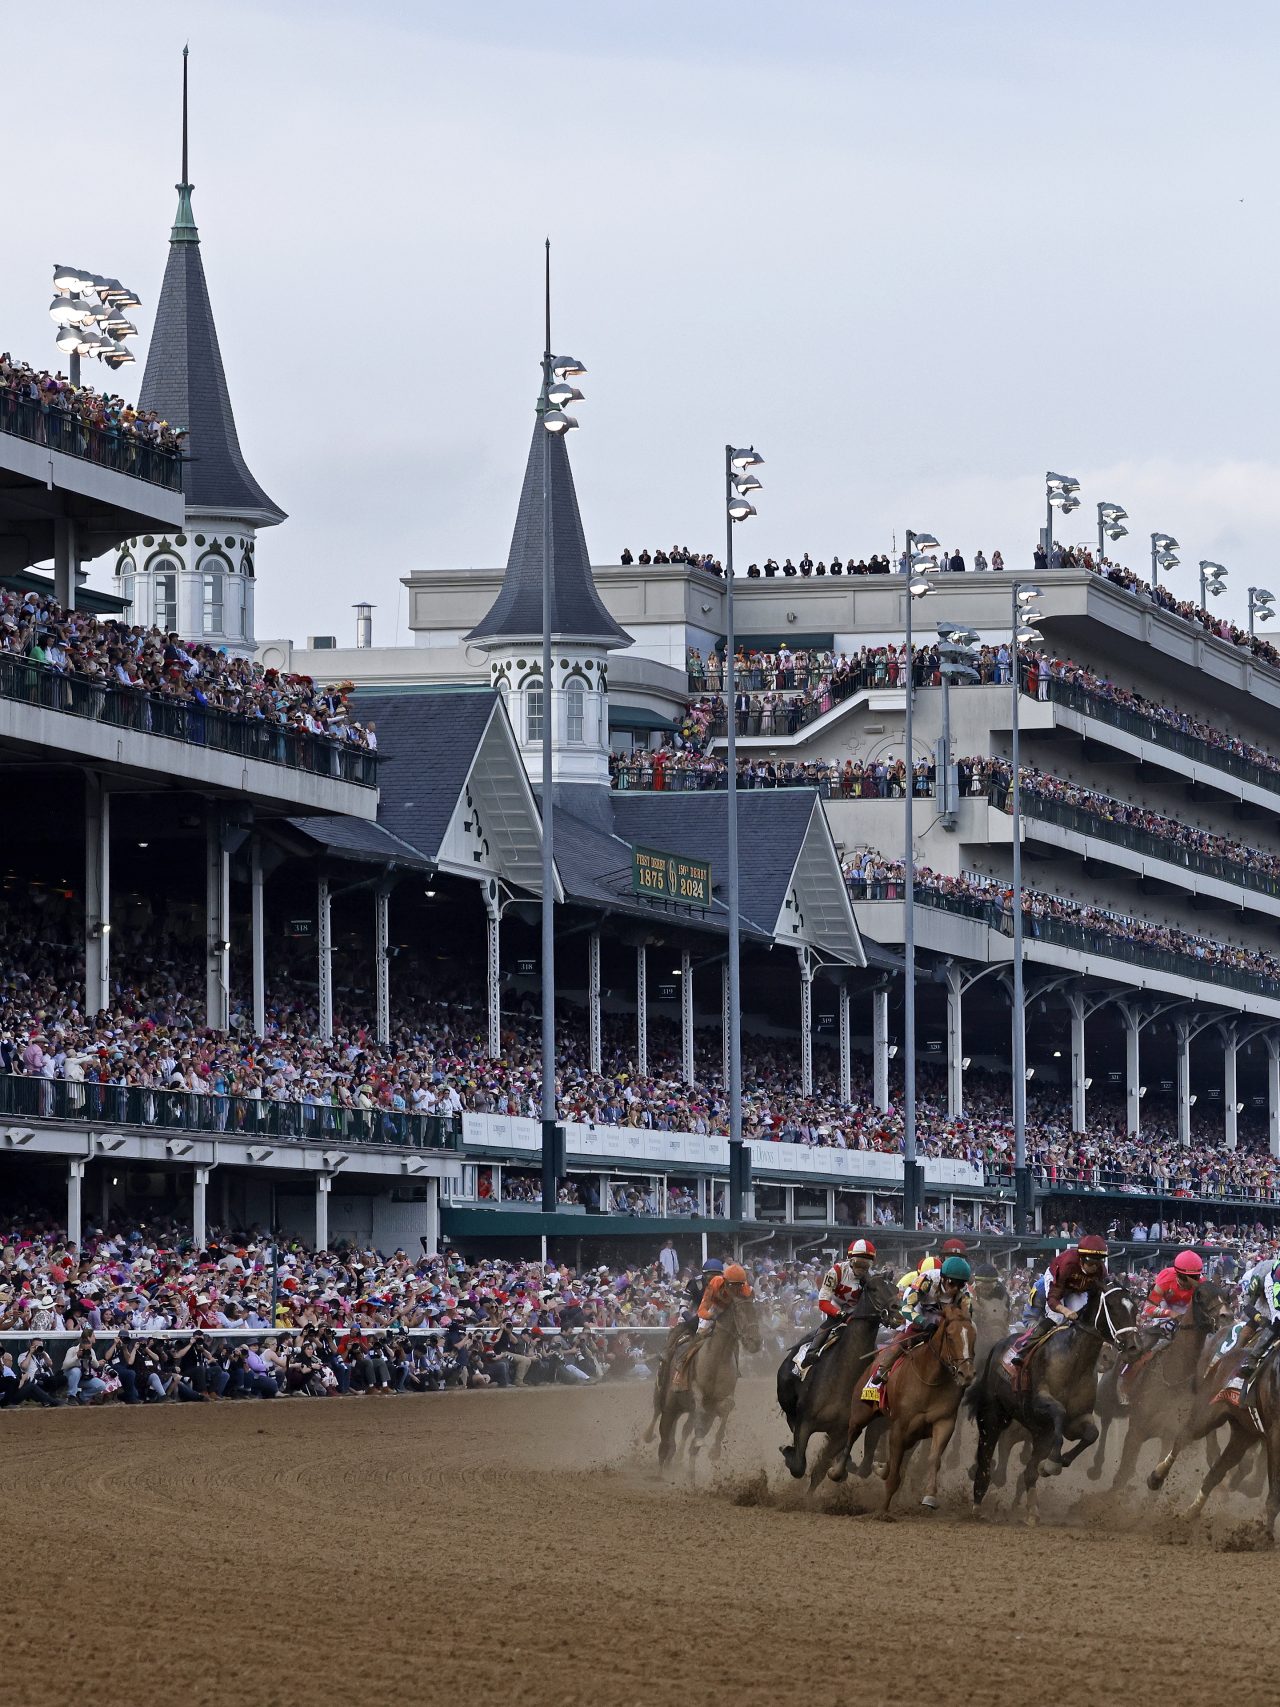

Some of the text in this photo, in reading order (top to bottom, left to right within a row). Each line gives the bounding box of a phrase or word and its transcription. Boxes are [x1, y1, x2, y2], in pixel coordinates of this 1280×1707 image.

[636, 853, 650, 867] FIRST
[639, 868, 664, 890] 1875
[680, 878, 704, 899] 2024
[823, 1274, 833, 1288] 15
